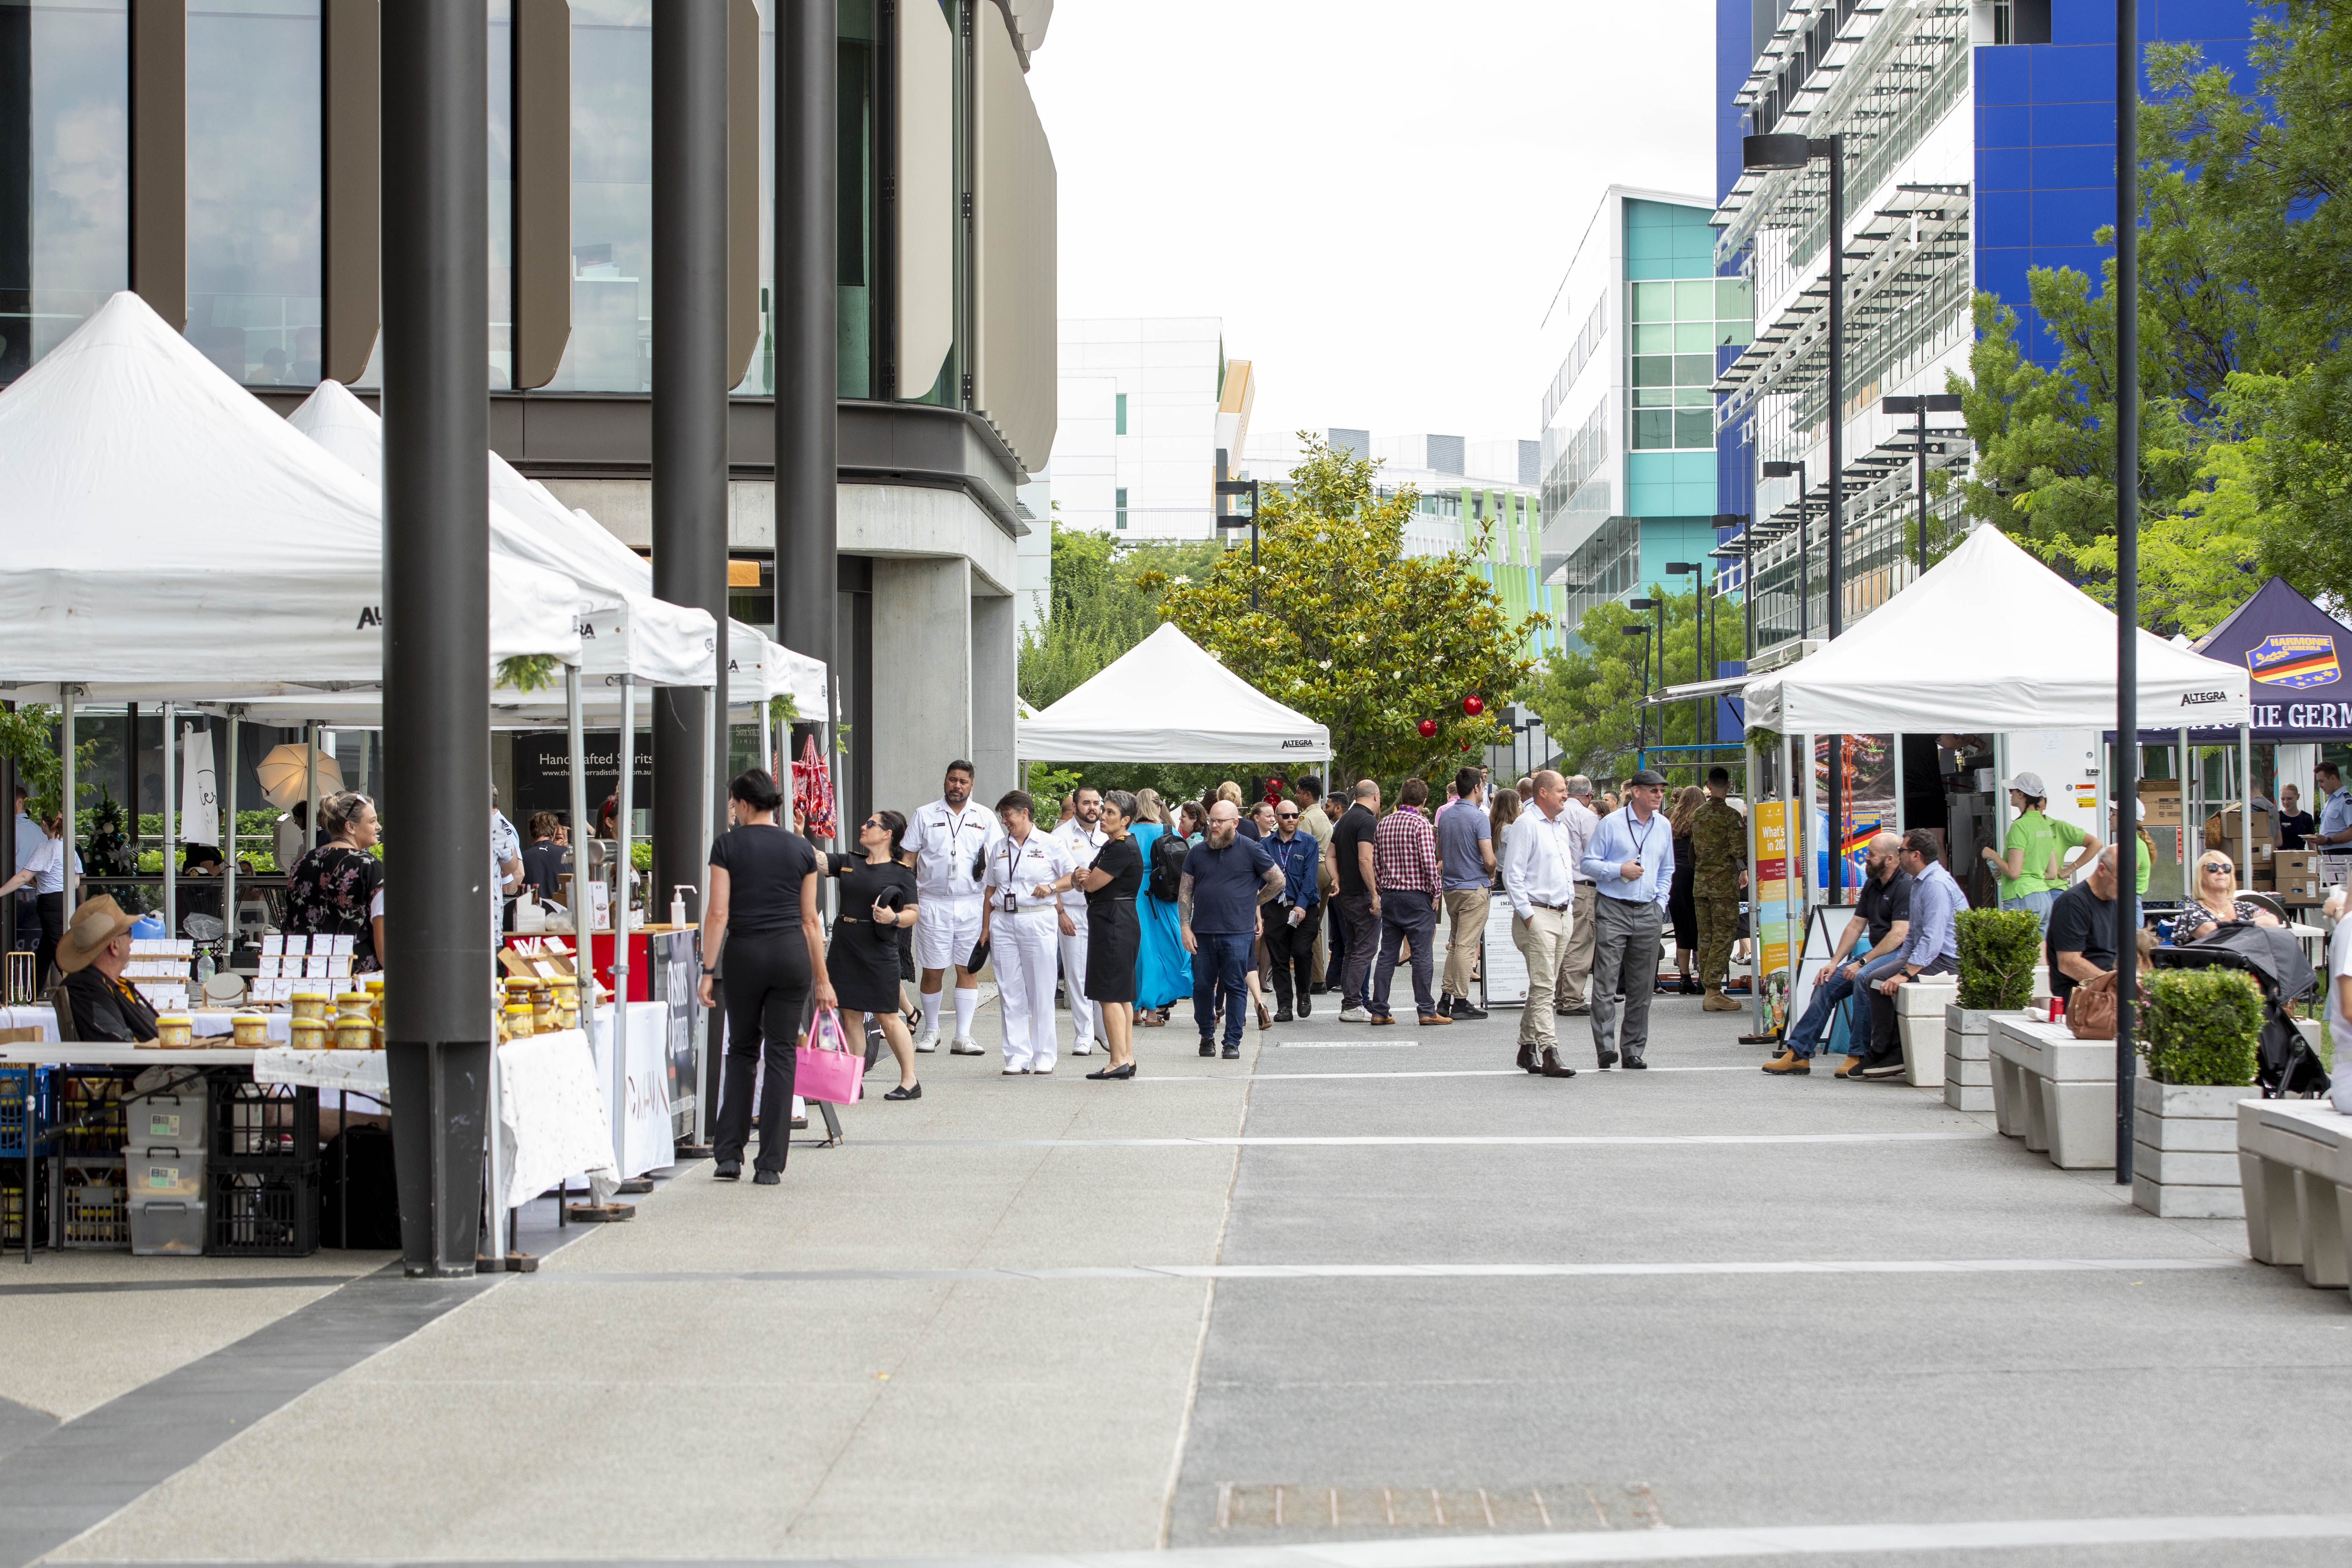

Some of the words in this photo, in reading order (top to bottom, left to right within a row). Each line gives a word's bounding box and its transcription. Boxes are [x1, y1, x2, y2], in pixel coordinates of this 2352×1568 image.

[2270, 638, 2331, 646] HARMONIE
[2180, 691, 2226, 706] ALTEGRA
[1281, 739, 1313, 749] ALTEGRA
[1762, 825, 1785, 838] What's
[1767, 840, 1774, 851] in
[1775, 838, 1786, 851] 202
